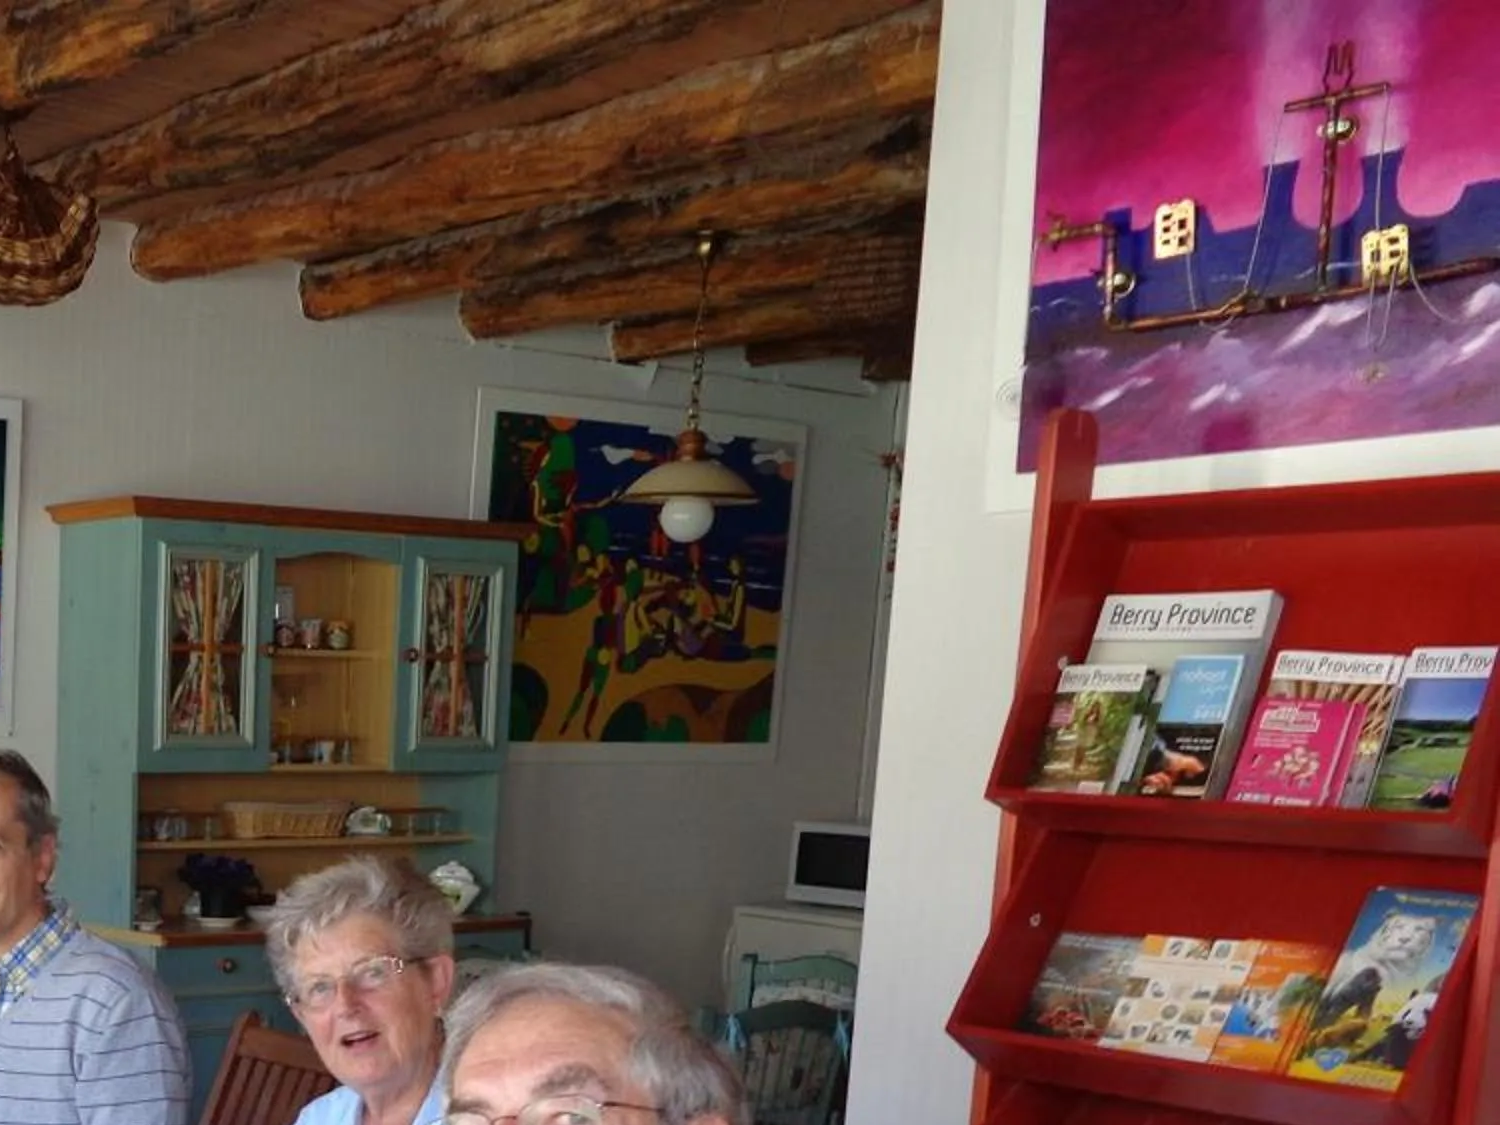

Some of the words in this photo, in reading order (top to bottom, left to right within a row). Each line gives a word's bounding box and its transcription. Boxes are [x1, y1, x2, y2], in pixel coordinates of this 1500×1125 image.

[1109, 603, 1162, 631] Berry
[1165, 602, 1257, 625] Province
[1279, 654, 1315, 674] Berry
[1317, 656, 1384, 675] Province
[1414, 652, 1457, 672] Berry
